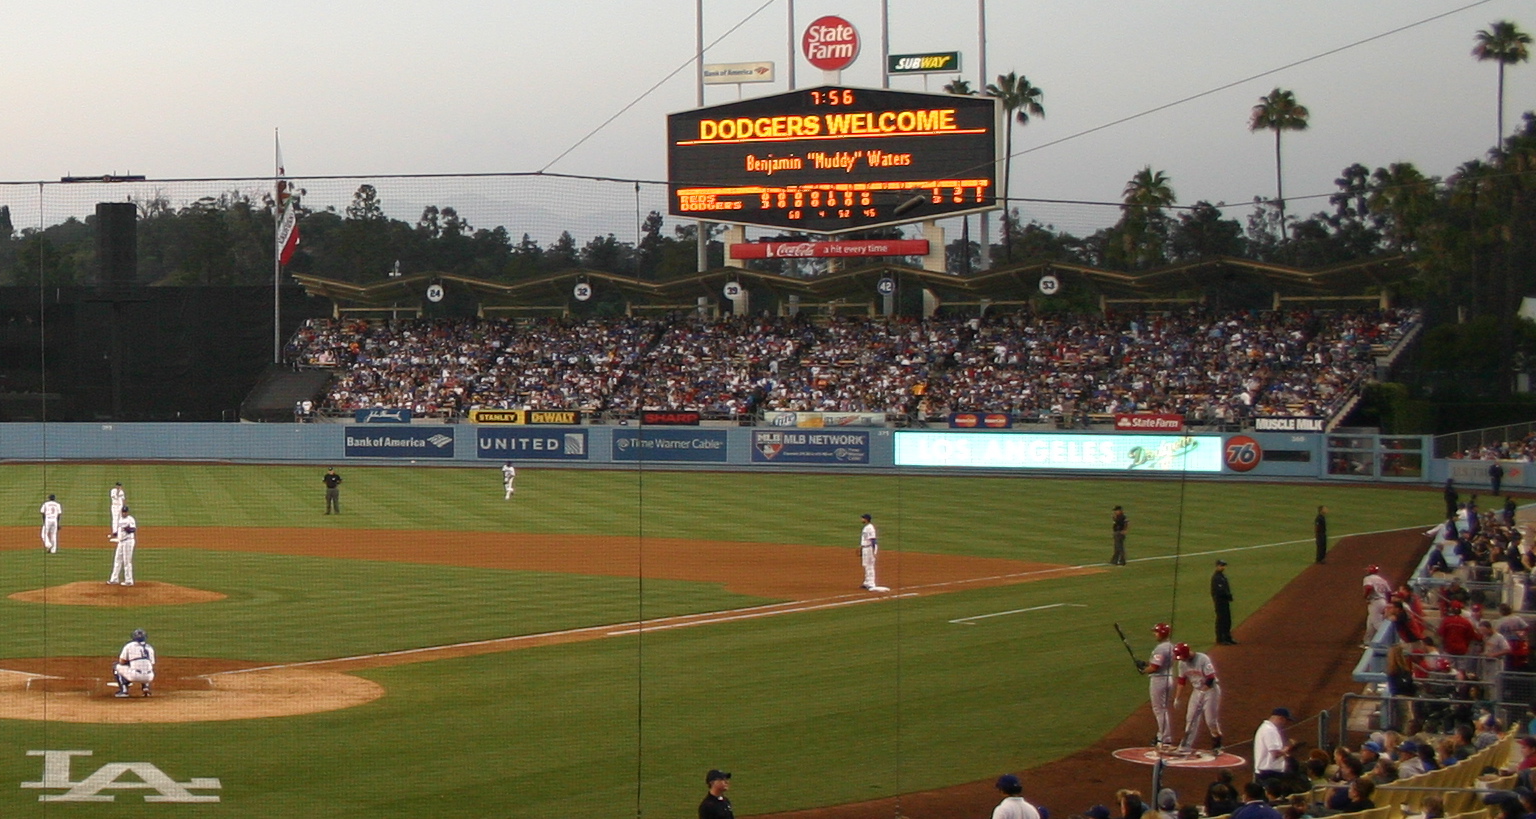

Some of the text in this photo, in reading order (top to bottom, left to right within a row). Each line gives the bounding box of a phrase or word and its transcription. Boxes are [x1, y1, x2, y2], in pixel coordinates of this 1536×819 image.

[808, 25, 853, 43] State
[808, 43, 853, 60] Farm
[894, 55, 952, 70] SUBWAY
[704, 69, 753, 77] Bank of America
[811, 90, 853, 105] 7:56
[700, 109, 958, 140] DODGERS WELCOME
[746, 150, 912, 176] Benjamin "Muddy" Waters
[680, 201, 743, 211] DODGERS
[830, 246, 842, 254] hit
[844, 246, 866, 255] every
[868, 245, 888, 253] time
[478, 413, 515, 422] STANLEY
[645, 413, 698, 424] SHARP
[1132, 417, 1178, 428] State Farm
[1256, 419, 1324, 431] MUSCLE MILK
[346, 436, 425, 447] Bank of America
[480, 438, 559, 450] UNITED
[630, 438, 720, 449] Time Warner Cable
[757, 434, 781, 442] MLB
[784, 435, 863, 445] MLB NETWORK
[919, 439, 971, 461] LOS
[984, 439, 1116, 463] ANGELES
[1226, 443, 1256, 463] 76
[20, 750, 222, 803] LA
